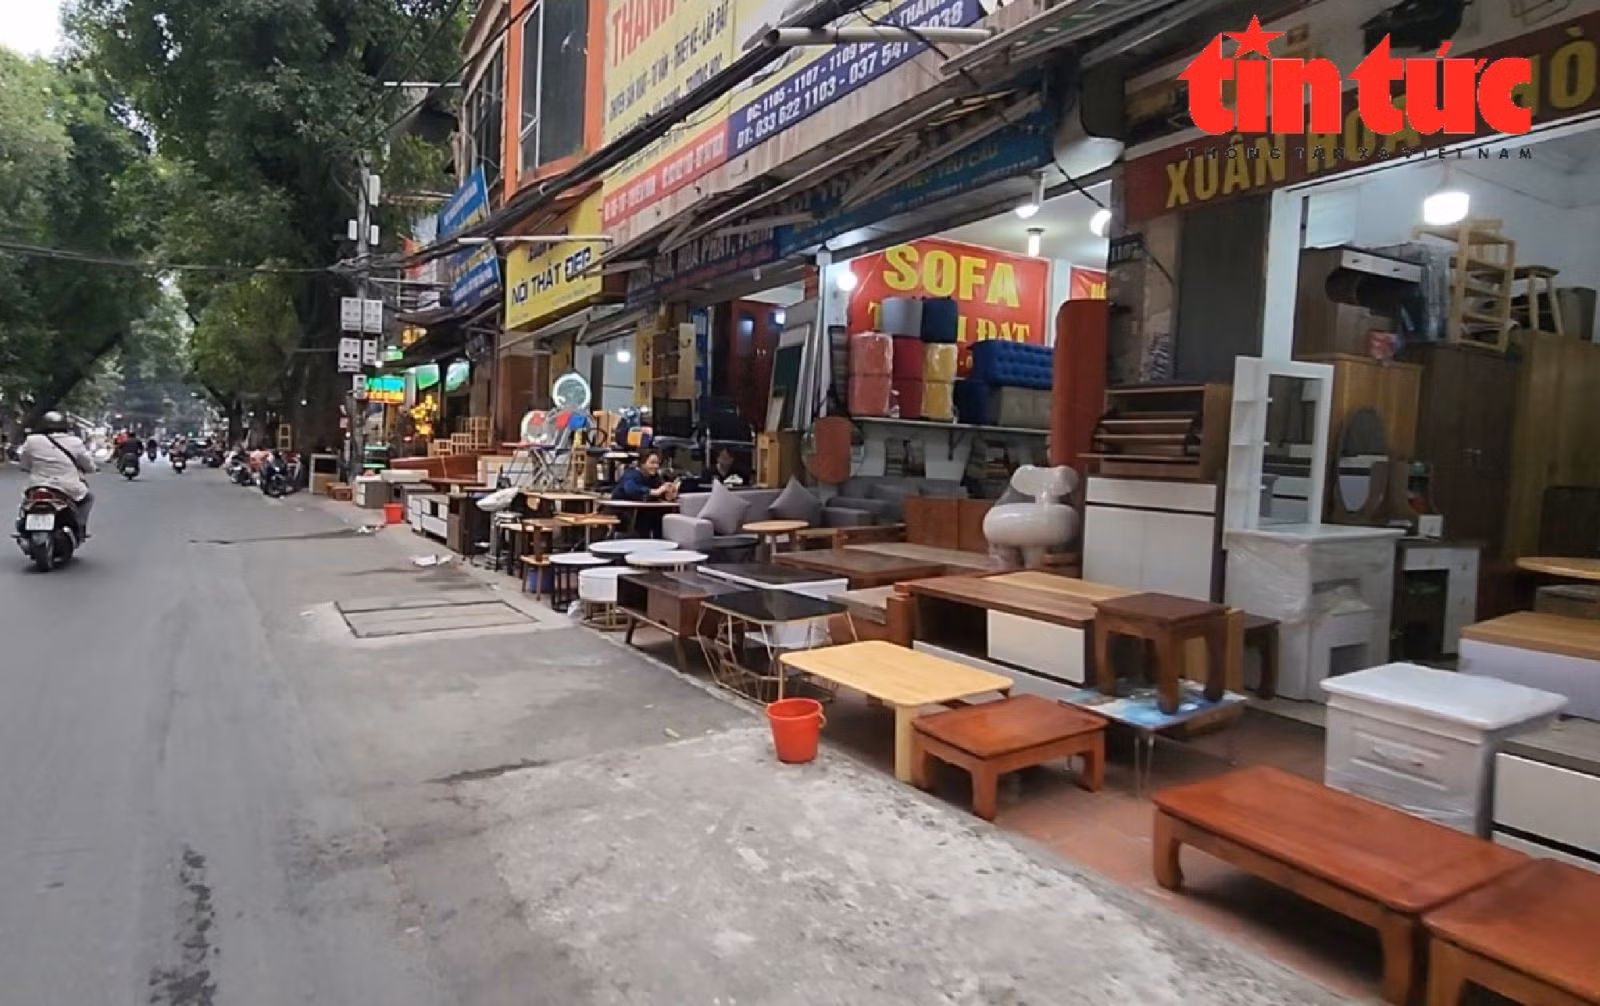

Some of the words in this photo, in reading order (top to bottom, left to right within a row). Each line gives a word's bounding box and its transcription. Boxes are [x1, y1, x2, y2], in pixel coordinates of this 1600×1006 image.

[755, 112, 776, 139] 033
[778, 97, 800, 125] 622
[804, 77, 836, 112] 1103
[849, 51, 878, 82] 037
[763, 89, 785, 113] 1105
[794, 67, 818, 94] 1107
[829, 43, 857, 72] 1109
[1165, 132, 1287, 209] XUÂN
[882, 243, 1021, 308] SOFA
